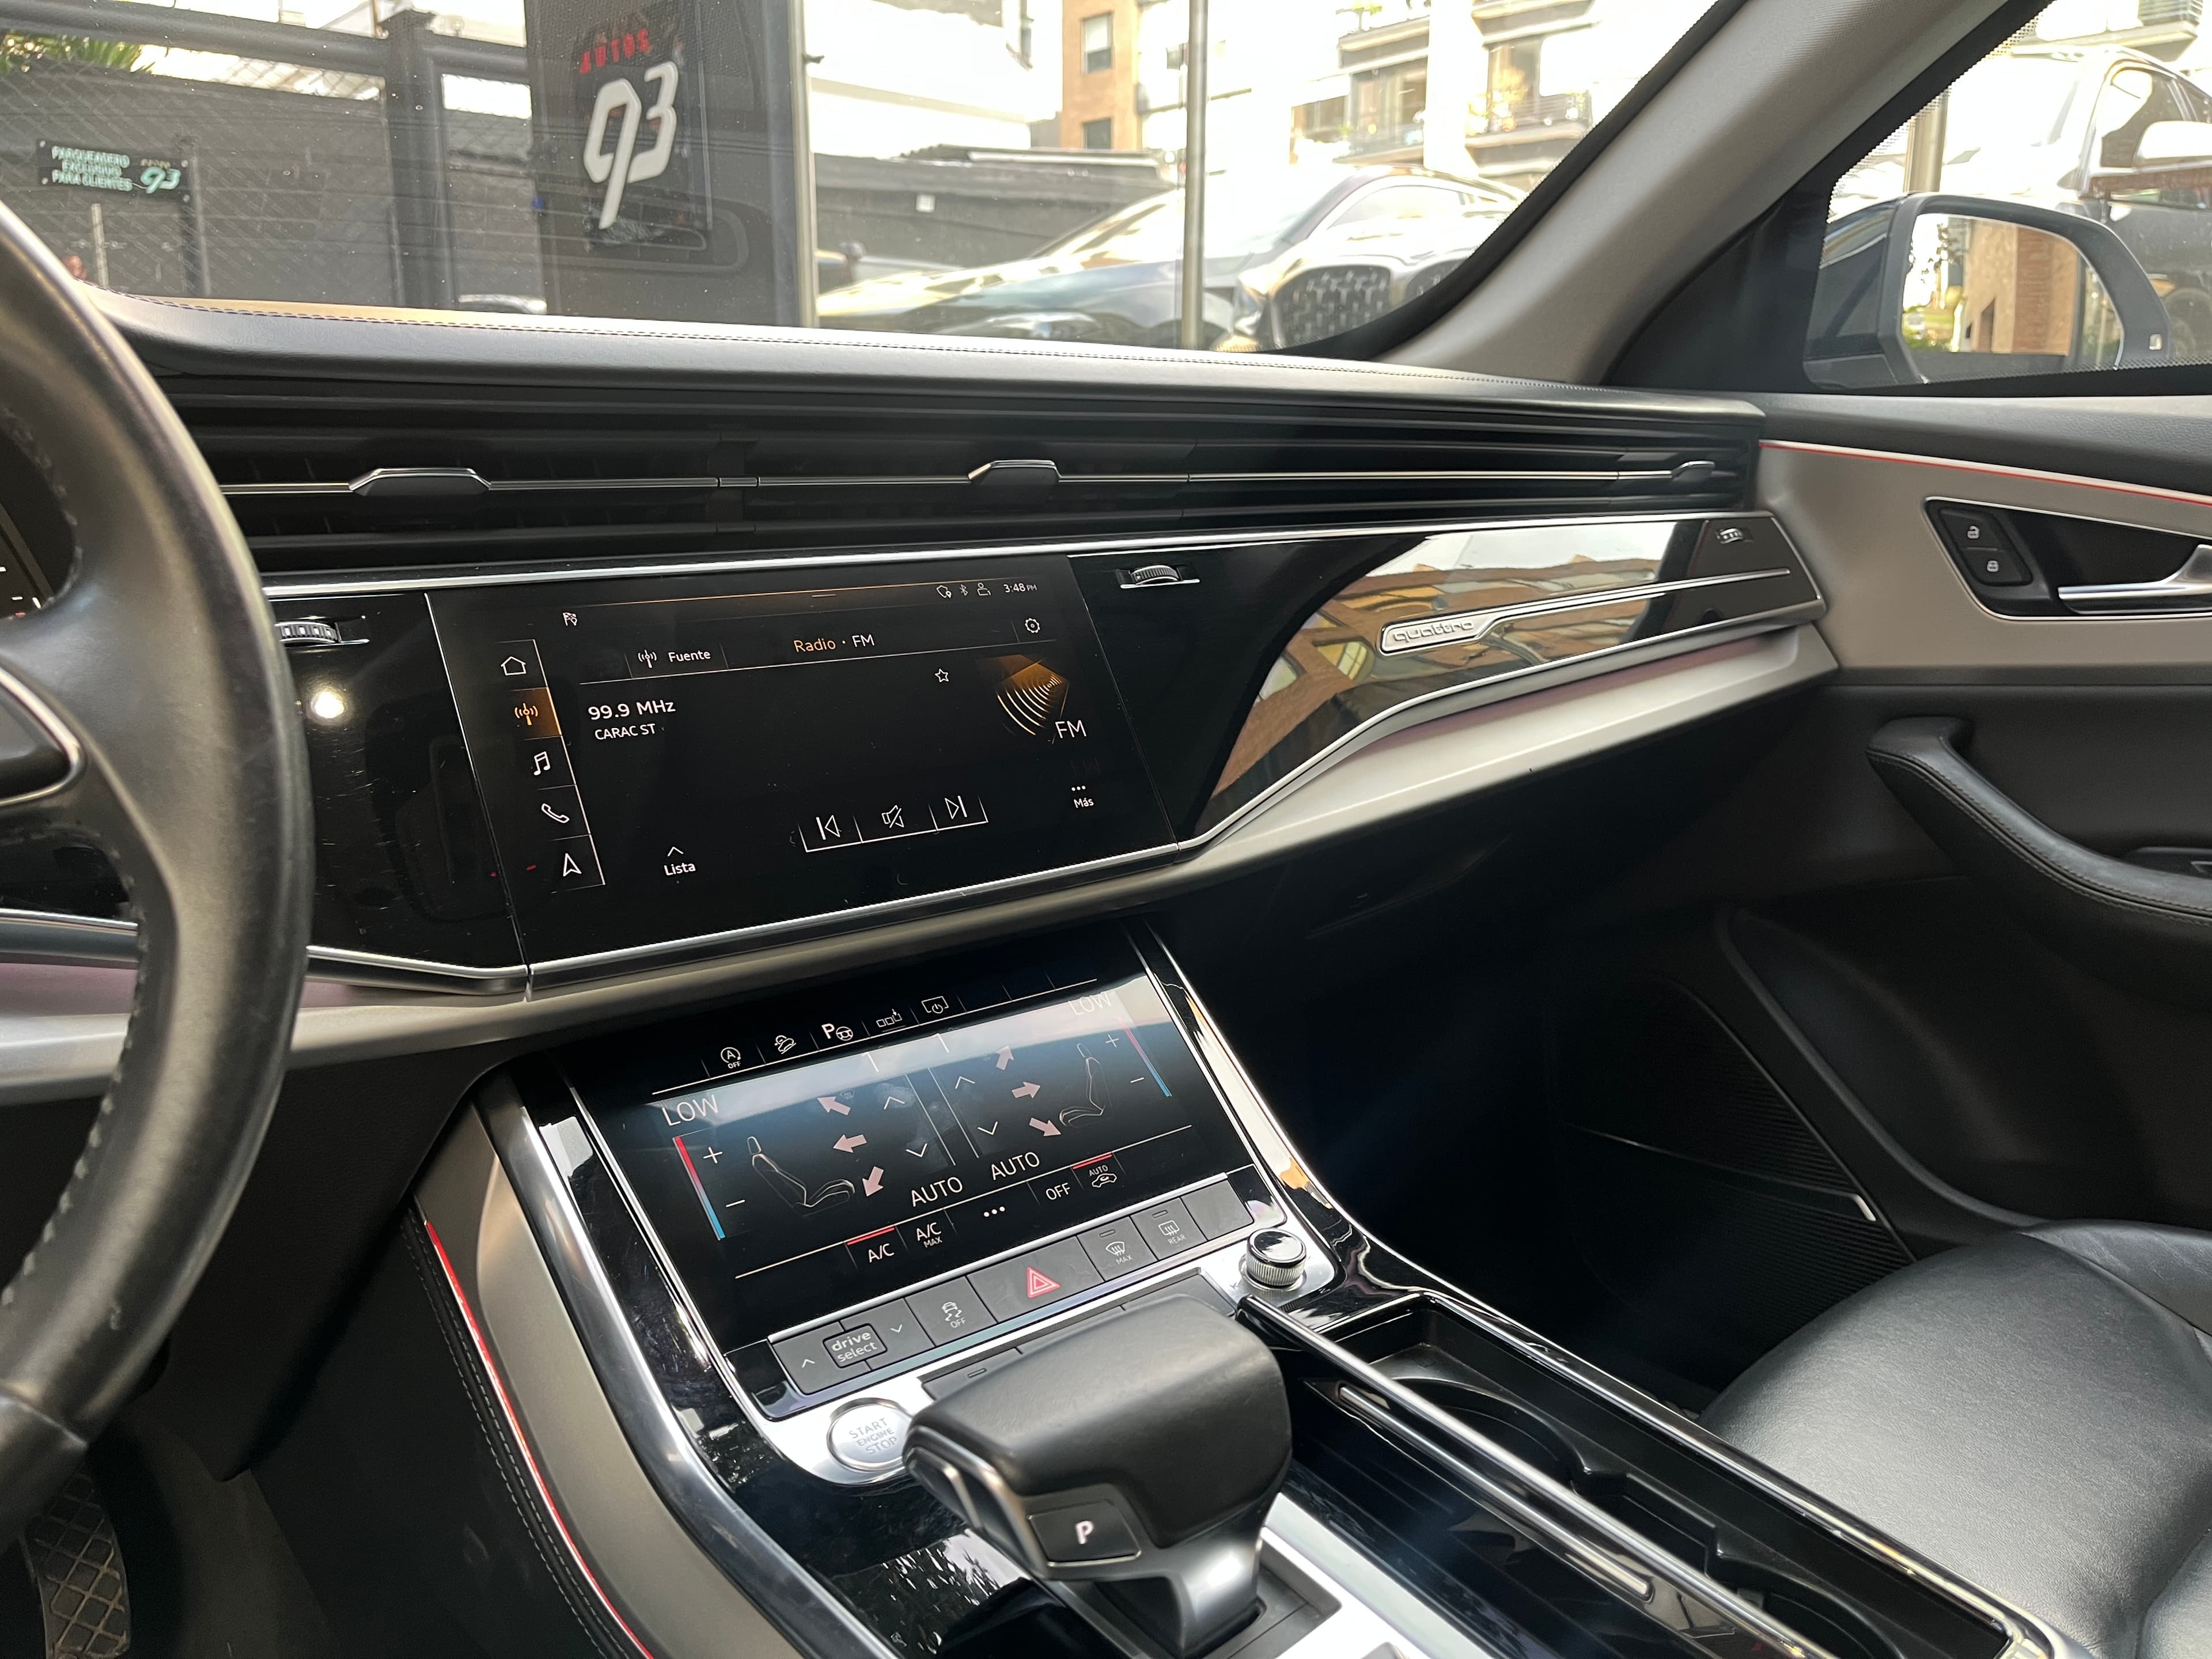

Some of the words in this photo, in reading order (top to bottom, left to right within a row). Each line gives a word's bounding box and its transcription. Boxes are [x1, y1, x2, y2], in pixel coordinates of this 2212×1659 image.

[579, 28, 650, 74] AUTOS
[583, 60, 679, 229] 93
[1003, 583, 1026, 593] 3:48
[1393, 620, 1475, 643] quattro
[793, 638, 836, 653] Radio
[852, 634, 875, 647] FM
[668, 650, 711, 662] Fuente
[588, 703, 630, 720] 99.9
[636, 699, 676, 715] MHz
[594, 725, 639, 740] CARAC
[639, 723, 656, 735] ST
[1055, 719, 1087, 738] FM
[1073, 797, 1094, 808] Más
[664, 862, 696, 876] Lista
[1067, 991, 1111, 1016] LOW
[821, 1023, 835, 1039] P
[728, 1061, 741, 1069] OFF
[662, 1094, 719, 1126] LOW
[990, 1152, 1040, 1181] AUTO
[1089, 1165, 1108, 1177] AUTO
[911, 1177, 963, 1207] AUTO
[1046, 1183, 1071, 1200] OFF
[916, 1222, 942, 1241] A/C
[1168, 1234, 1187, 1245] REAR
[923, 1236, 943, 1248] MAX
[868, 1243, 895, 1263] A/C
[1116, 1254, 1133, 1265] MAX
[950, 1317, 967, 1328] OFF
[831, 1331, 872, 1352] drive
[837, 1341, 877, 1363] select
[849, 1418, 888, 1439] START
[855, 1427, 895, 1447] ENGINE
[865, 1437, 897, 1455] STOP
[1075, 1520, 1094, 1545] P
